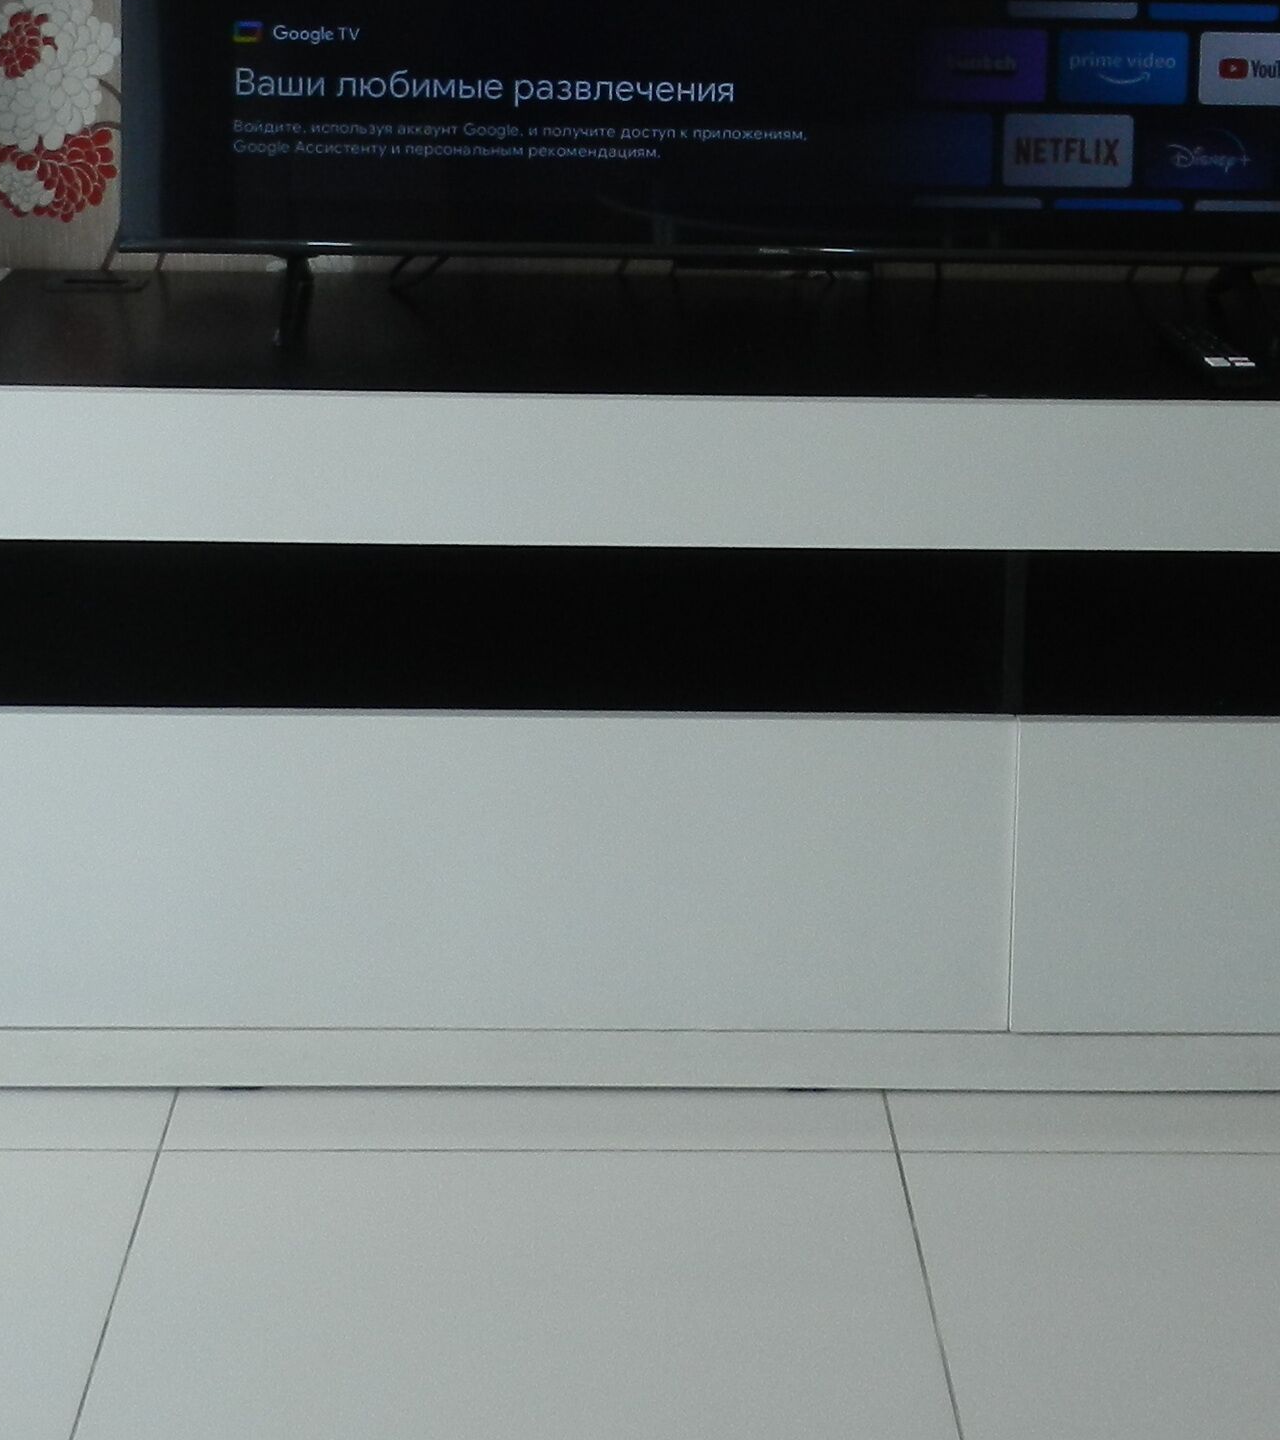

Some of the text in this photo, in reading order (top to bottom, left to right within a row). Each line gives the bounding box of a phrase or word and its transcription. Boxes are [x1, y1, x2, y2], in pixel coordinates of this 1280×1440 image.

[273, 24, 361, 45] Google TV
[1069, 51, 1177, 72] prime video
[235, 67, 735, 108] Ваши любимые развлечения
[311, 124, 393, 137] используя
[397, 125, 458, 139] аккаунт
[528, 126, 538, 137] и
[543, 125, 616, 141] получите
[620, 127, 676, 141] доступ
[233, 139, 290, 157] Google
[391, 143, 401, 155] и
[1016, 137, 1120, 168] NETFLIX
